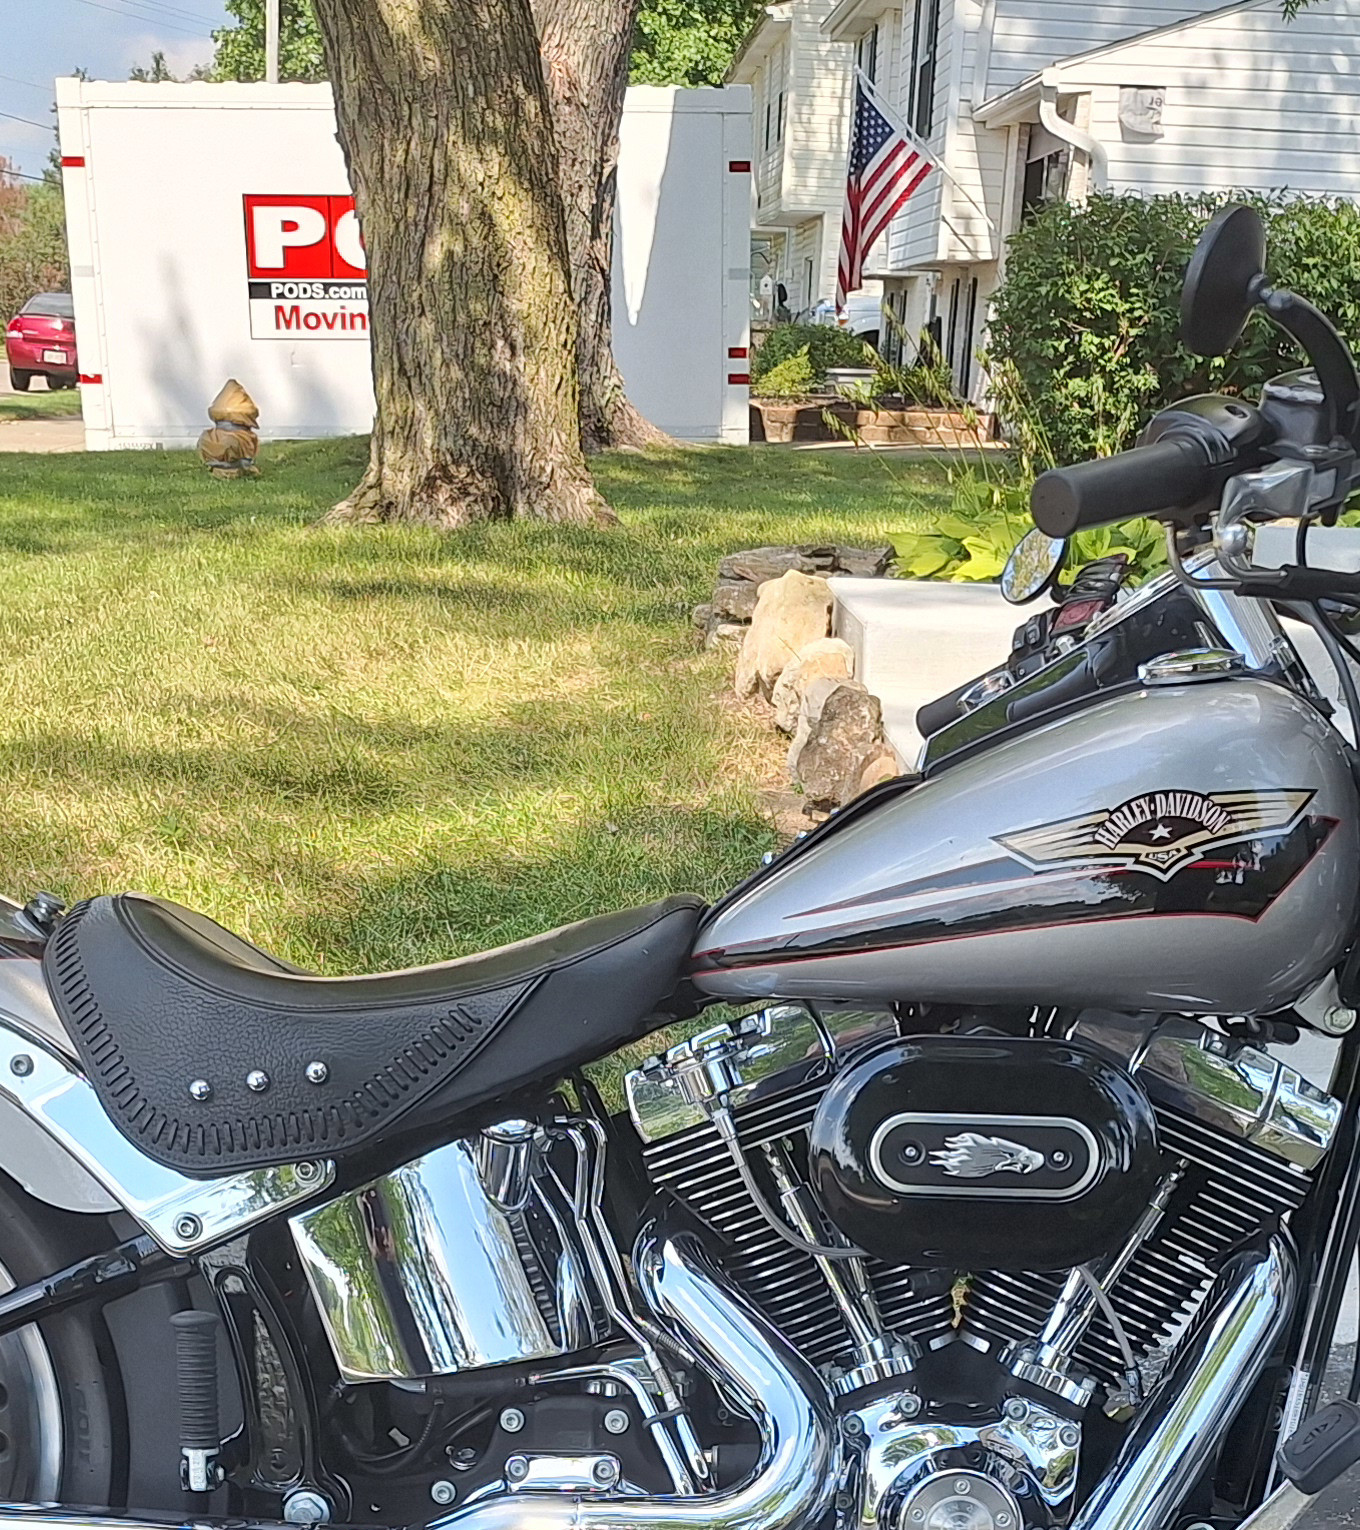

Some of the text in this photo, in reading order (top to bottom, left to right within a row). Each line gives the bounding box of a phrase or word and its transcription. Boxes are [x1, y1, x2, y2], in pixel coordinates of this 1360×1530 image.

[271, 283, 367, 298] PODS.com
[274, 305, 369, 330] Movin
[1148, 848, 1181, 862] USA
